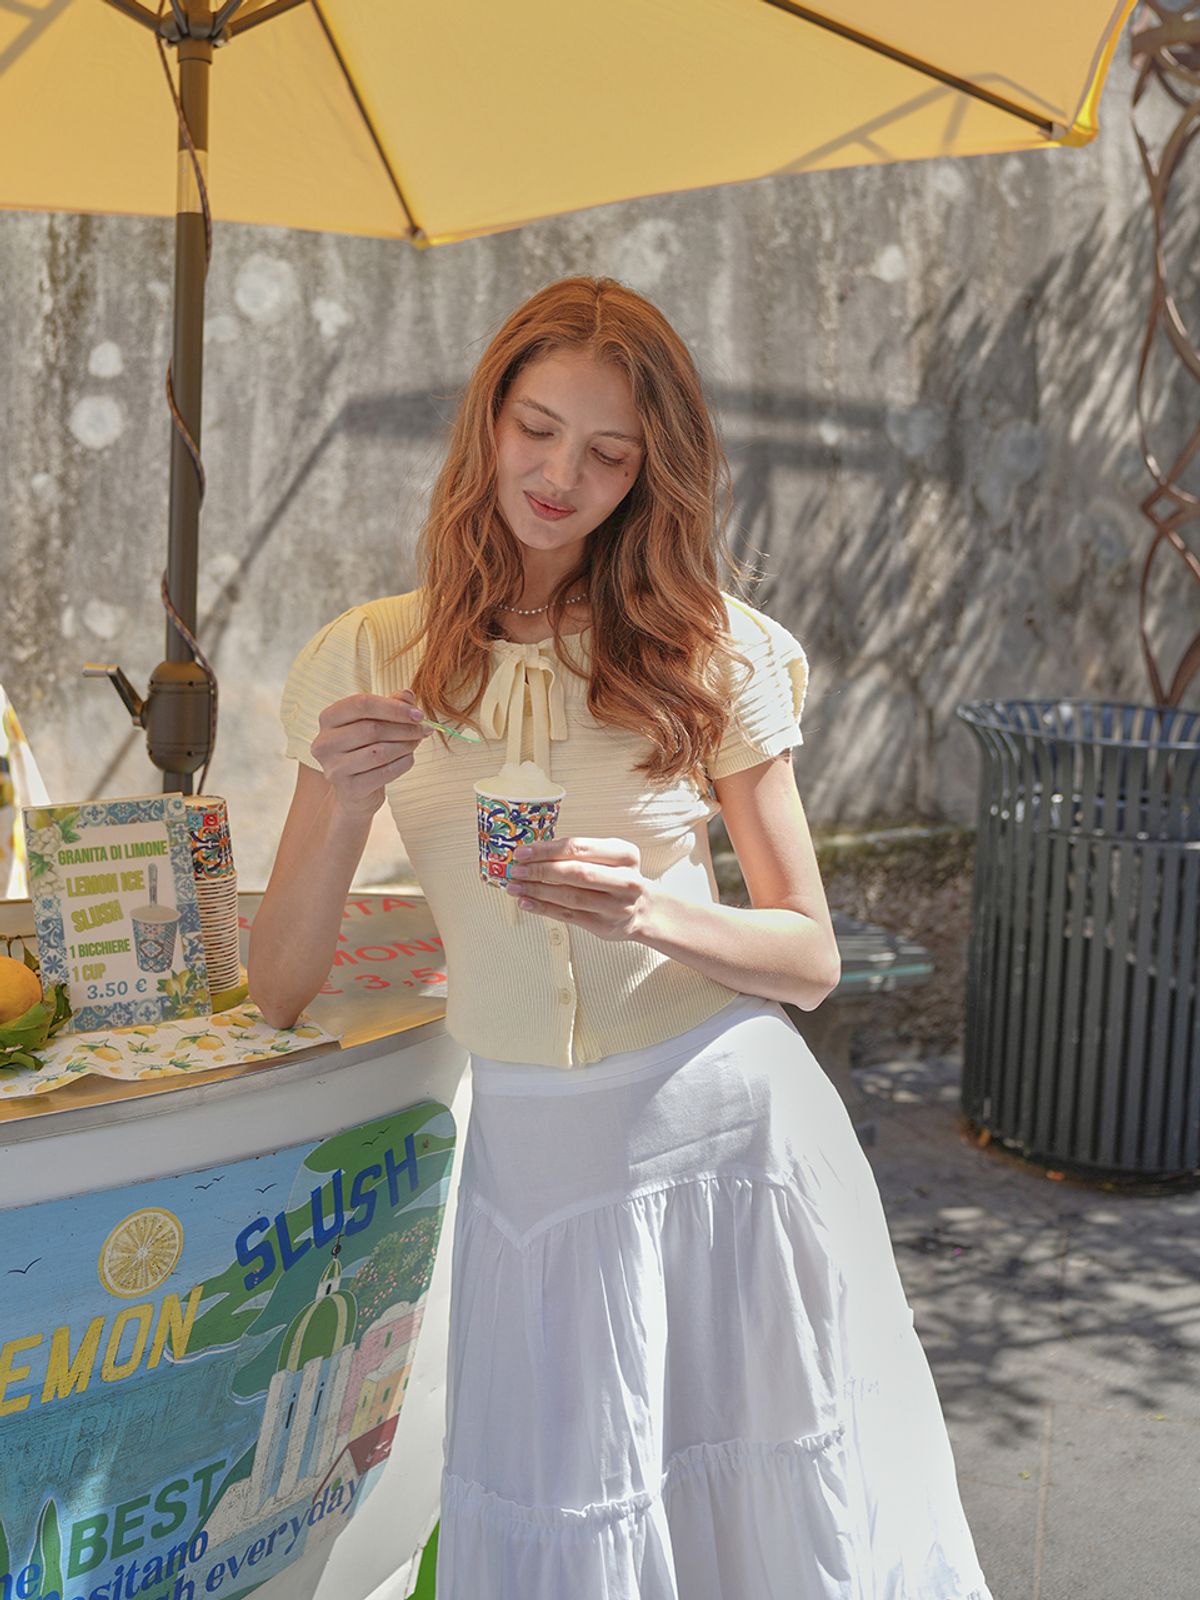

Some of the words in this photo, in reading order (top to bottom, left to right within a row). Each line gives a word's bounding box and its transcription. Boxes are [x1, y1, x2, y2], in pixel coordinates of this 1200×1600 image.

[57, 846, 108, 866] GRANITA
[110, 844, 122, 861] DI
[125, 840, 169, 859] LIMONE
[65, 873, 119, 898] LEMON
[120, 870, 145, 892] ICE
[71, 900, 124, 932] SLUSH
[69, 945, 76, 959] 1
[78, 938, 131, 958] BICCHIERE
[72, 965, 79, 982] 1
[82, 962, 106, 981] CUP
[87, 980, 128, 999] 3.50
[135, 978, 147, 993] €
[235, 1133, 420, 1291] SLUSH
[67, 1460, 226, 1580] BEST
[206, 1479, 359, 1592] everyday
